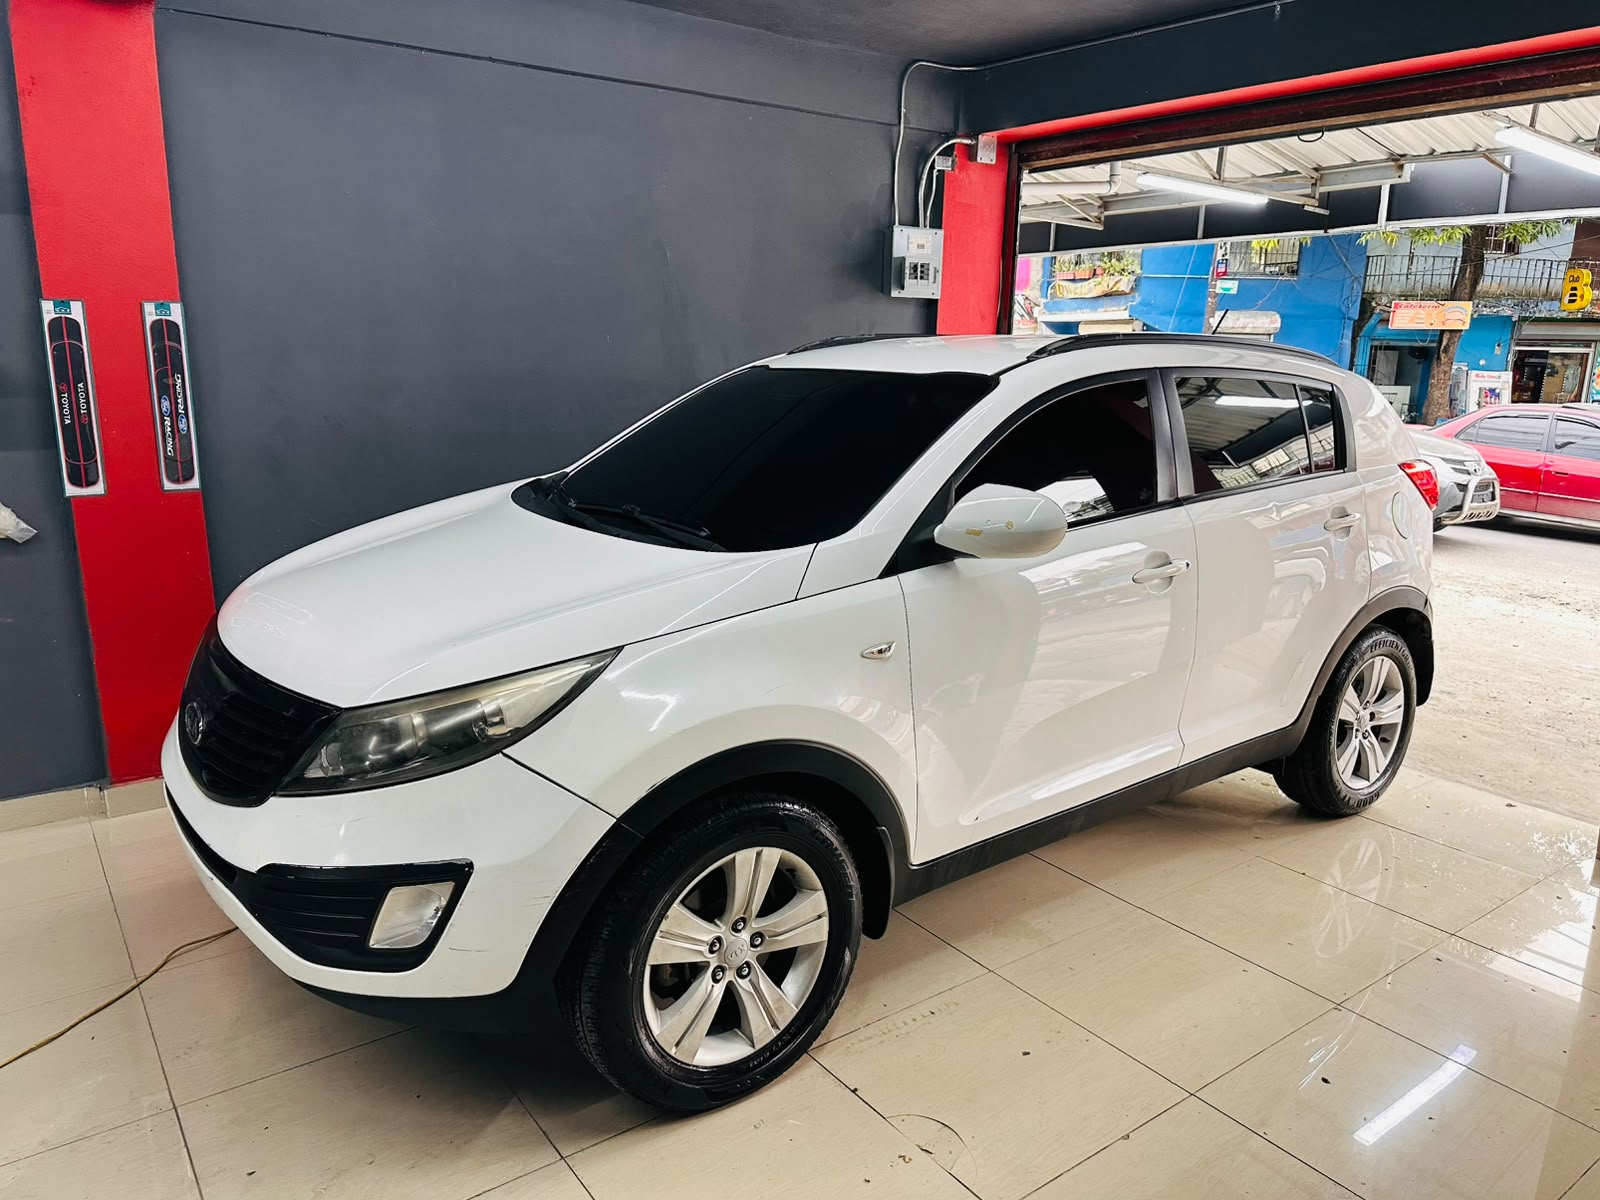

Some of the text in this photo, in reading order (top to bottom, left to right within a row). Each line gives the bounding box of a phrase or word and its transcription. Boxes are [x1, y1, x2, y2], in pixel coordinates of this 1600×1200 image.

[61, 392, 71, 425] TOYOTA
[77, 382, 88, 414] TOYOTA
[174, 373, 185, 414] RACING
[163, 416, 174, 457] RACING
